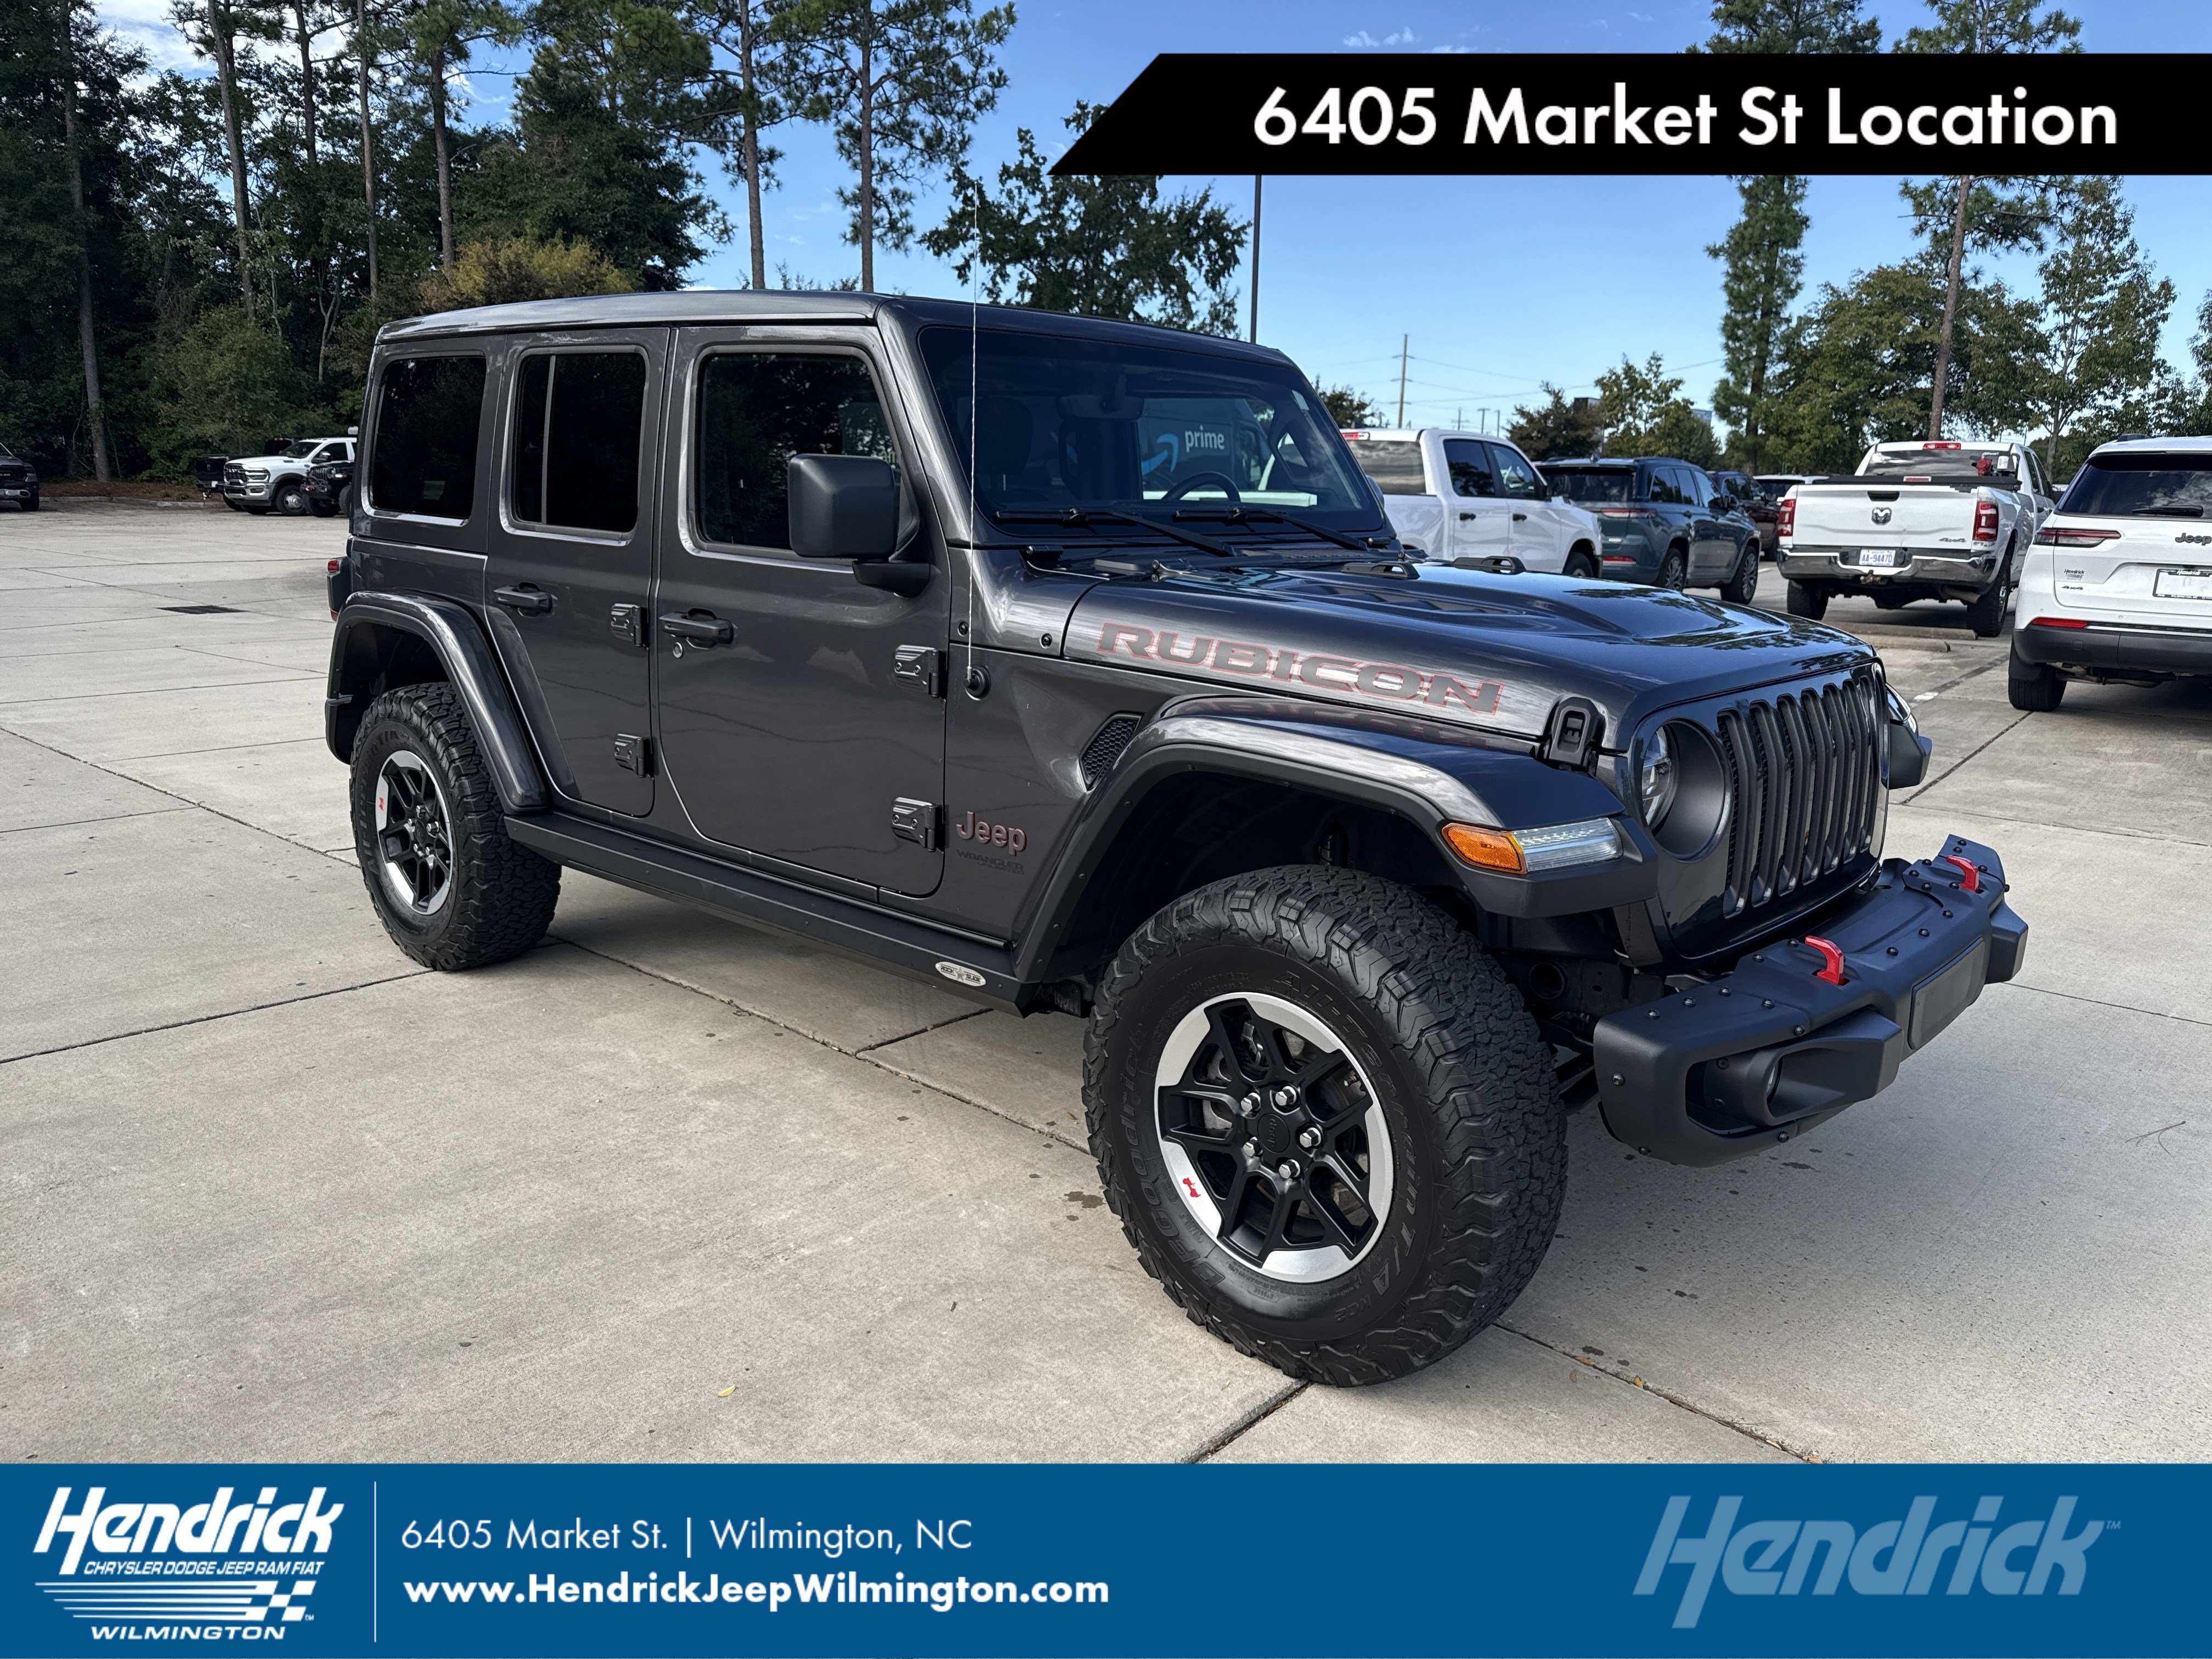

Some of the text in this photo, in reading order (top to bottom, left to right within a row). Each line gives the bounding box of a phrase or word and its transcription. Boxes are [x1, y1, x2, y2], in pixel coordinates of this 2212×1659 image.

[1185, 425, 1225, 453] prime
[2175, 533, 2212, 545] Jeep
[1097, 623, 1504, 715] RUBICON
[956, 811, 1028, 856] Jeep
[956, 849, 1024, 871] WRANGLER
[1120, 1020, 1225, 1294] BFGoodrich
[1367, 1221, 1421, 1296] T/A
